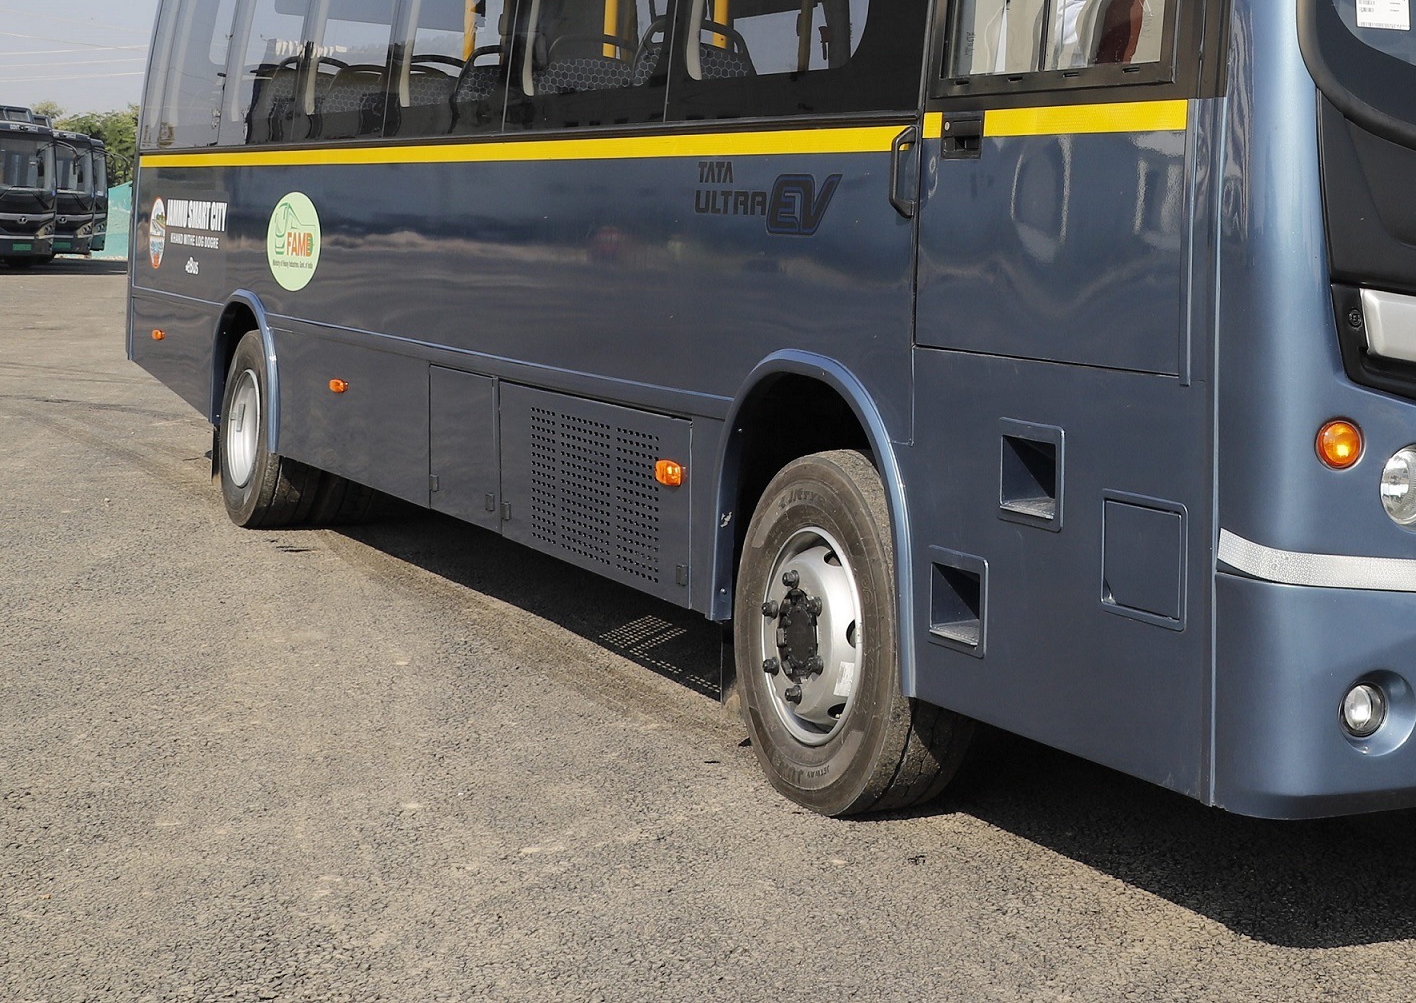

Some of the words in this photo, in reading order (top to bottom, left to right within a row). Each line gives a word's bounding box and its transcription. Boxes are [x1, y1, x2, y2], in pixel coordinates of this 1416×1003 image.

[698, 161, 734, 183] TATA
[166, 199, 188, 228] JAMMU
[187, 200, 211, 230] SMART
[210, 201, 228, 231] CITY
[695, 189, 767, 215] ULTRA
[766, 173, 843, 235] EV
[286, 231, 314, 257] FAME
